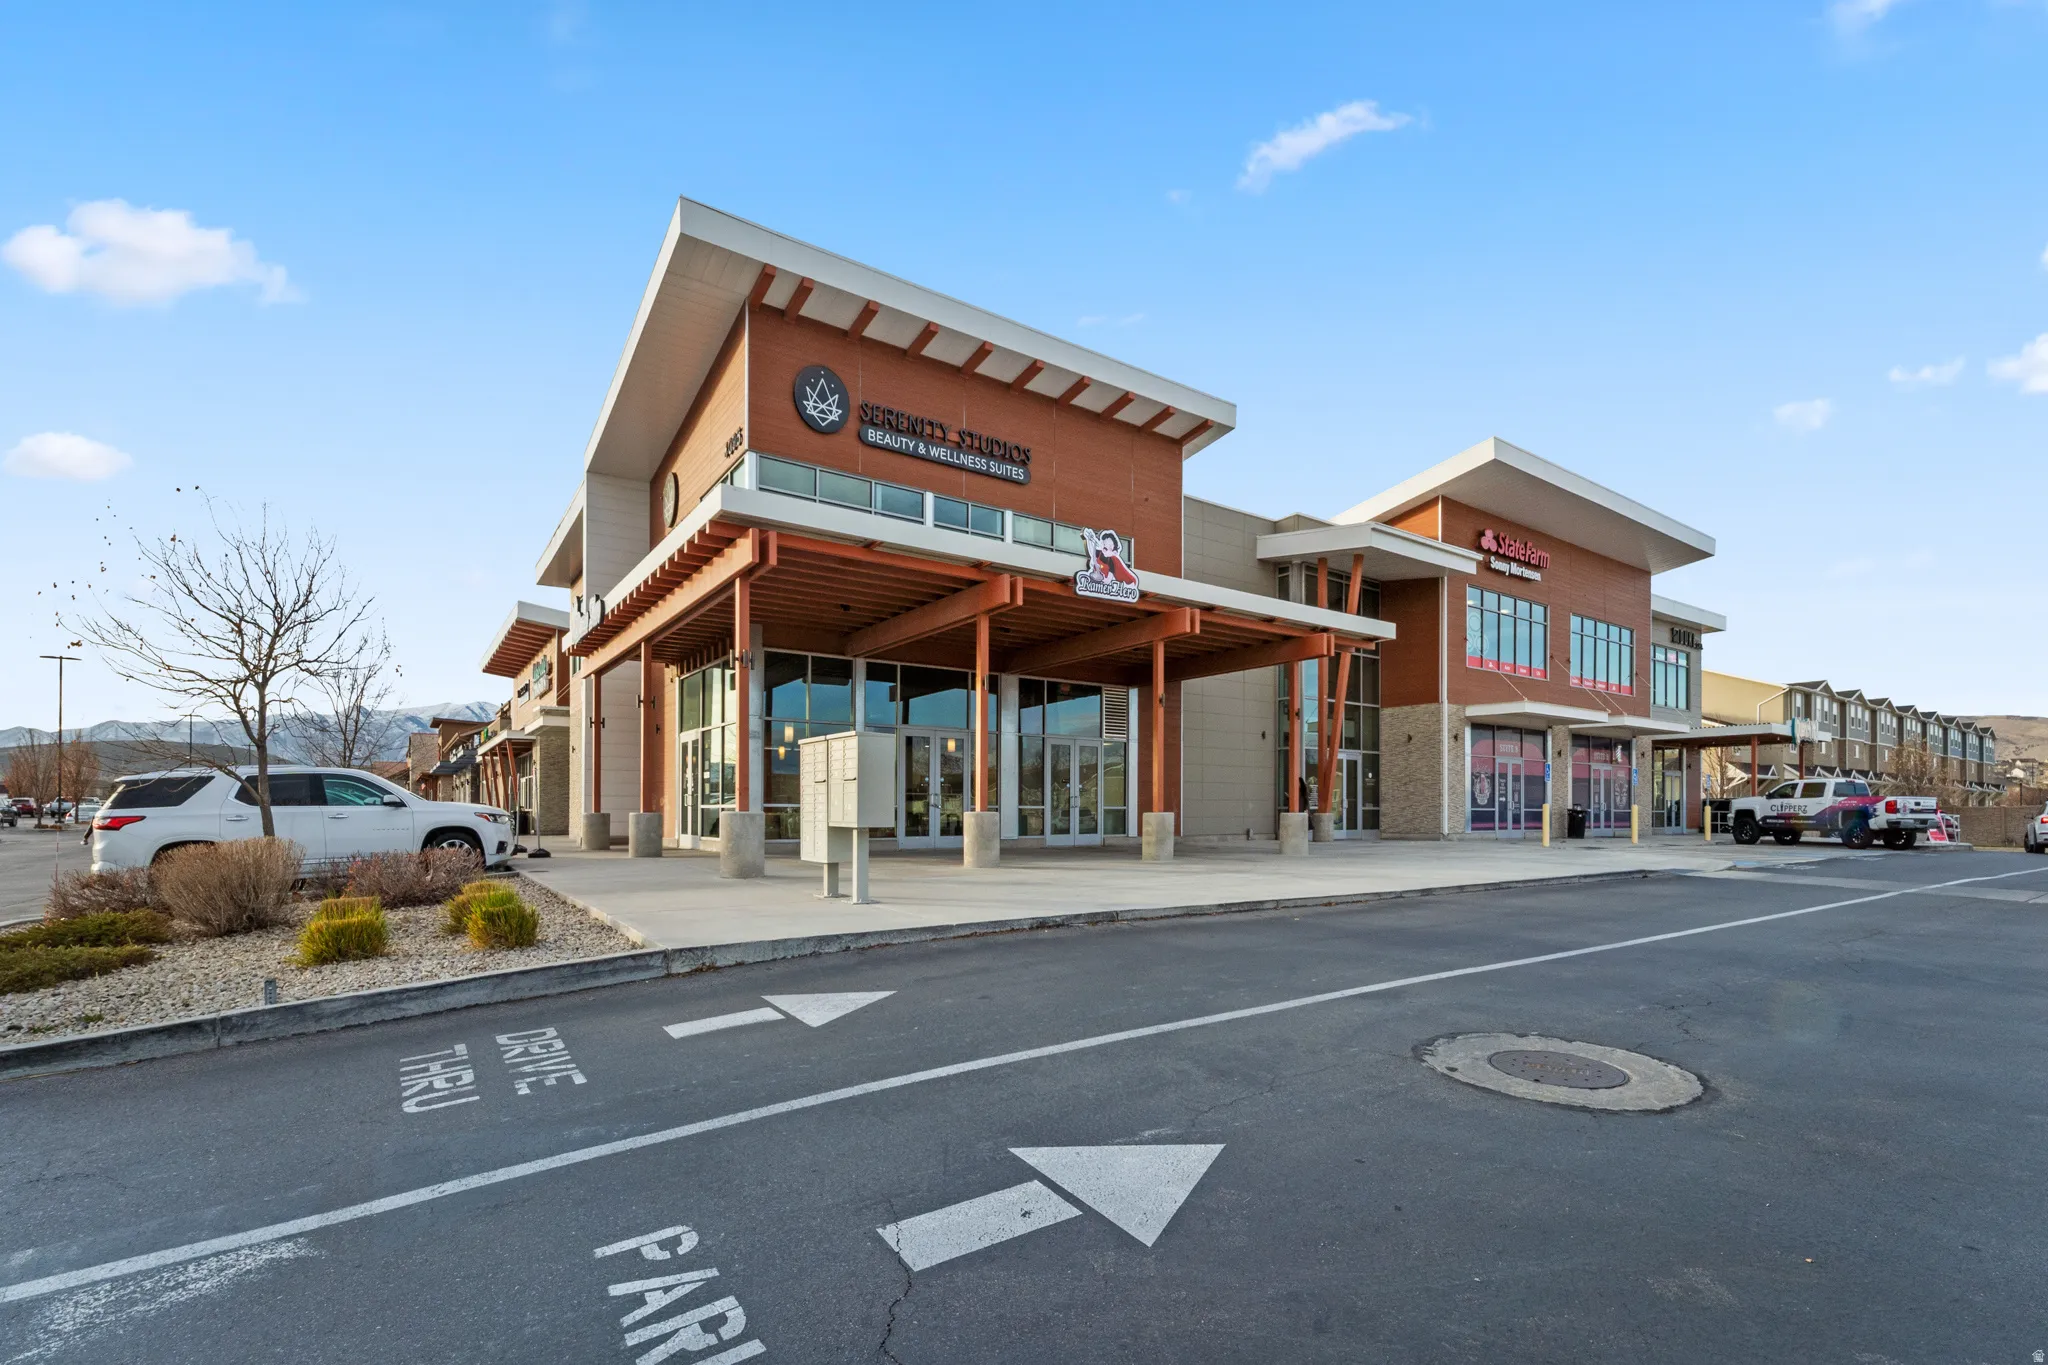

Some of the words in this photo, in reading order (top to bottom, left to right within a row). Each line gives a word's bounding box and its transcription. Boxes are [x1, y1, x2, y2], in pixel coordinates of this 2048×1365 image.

[860, 401, 950, 443] SERENITY
[958, 428, 1033, 465] STUDIOS
[868, 429, 916, 452] BEAUTY
[918, 442, 926, 455] &
[929, 444, 987, 471] WELLNESS
[989, 462, 1024, 480] SUITES
[1490, 556, 1510, 576] Sonny
[1511, 562, 1541, 581] Mortensen
[400, 1043, 480, 1113] THRU
[495, 1027, 587, 1095] DRIVE
